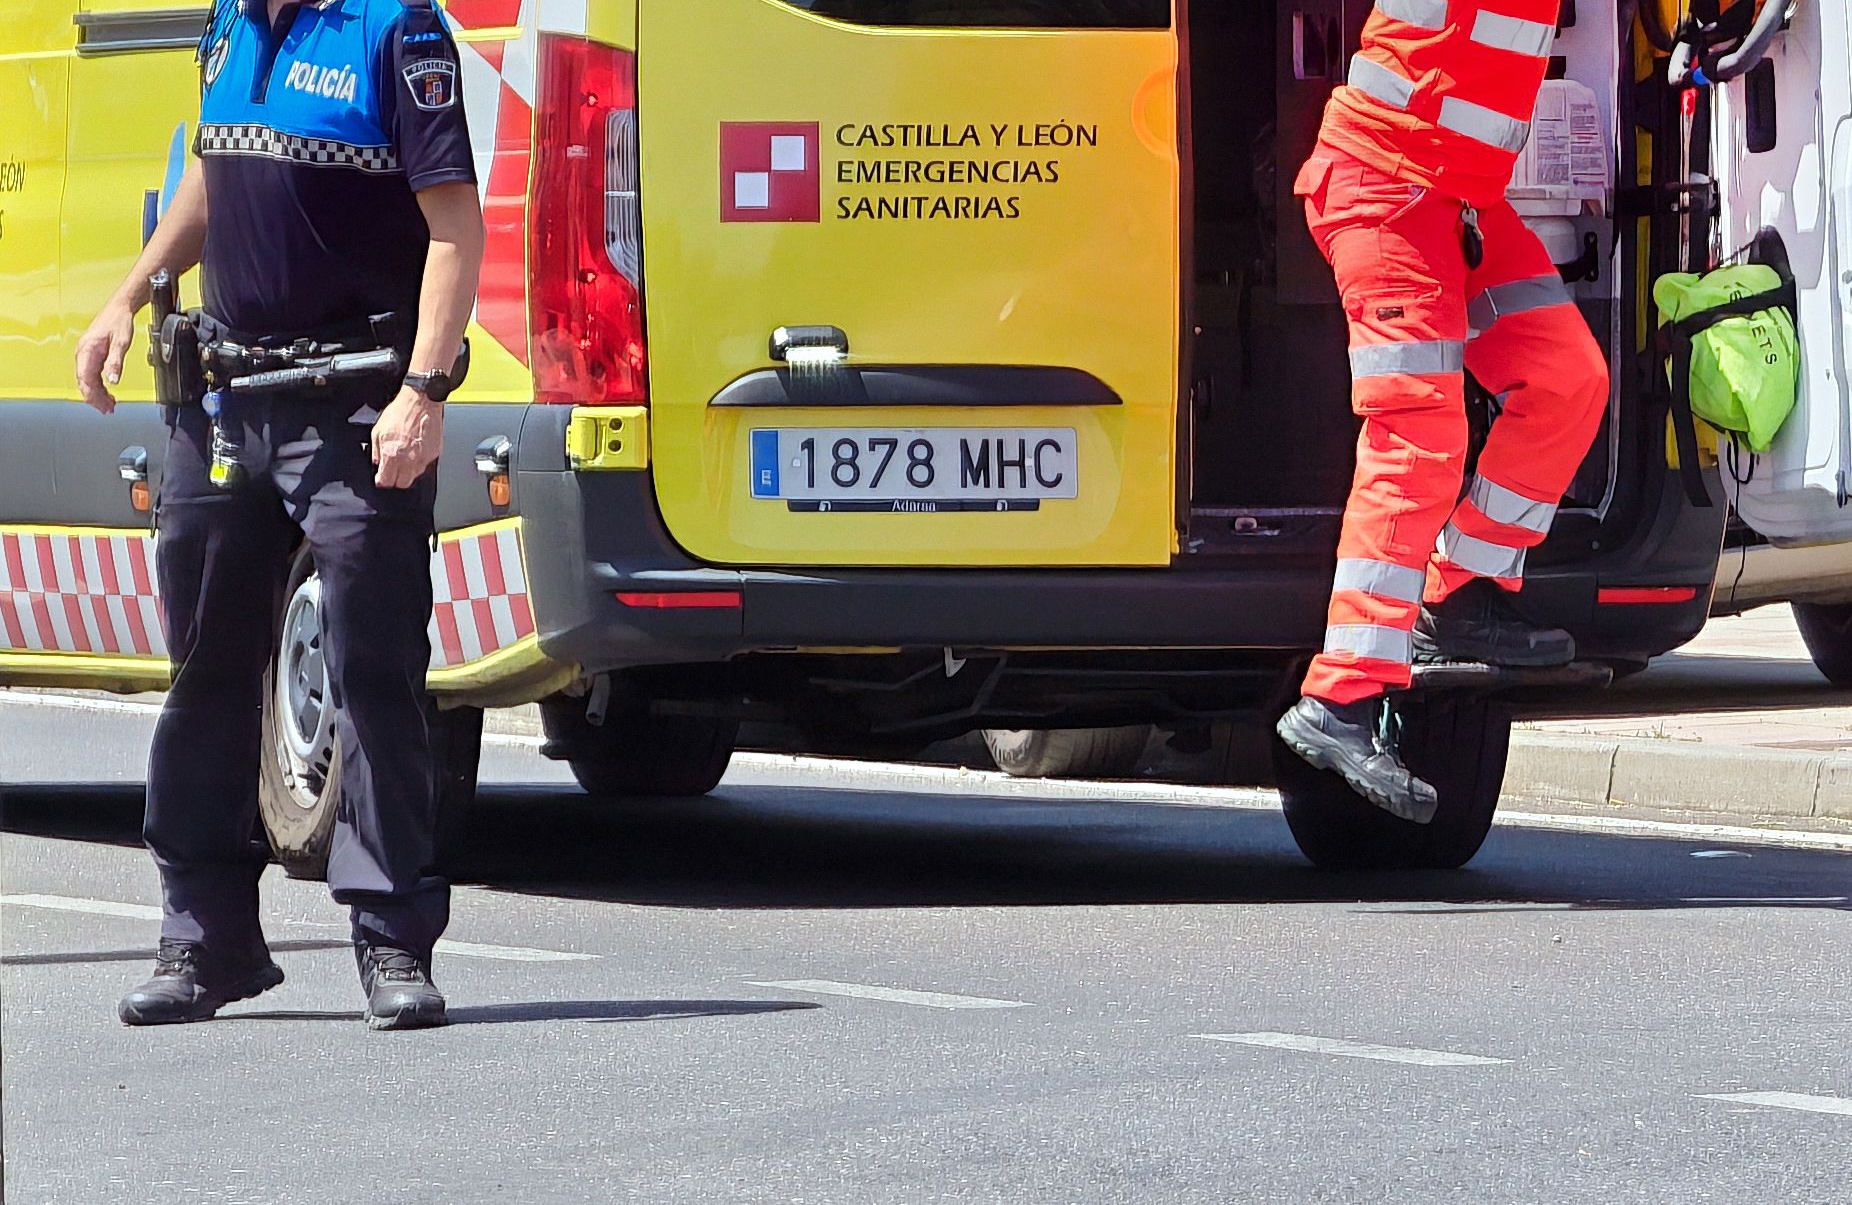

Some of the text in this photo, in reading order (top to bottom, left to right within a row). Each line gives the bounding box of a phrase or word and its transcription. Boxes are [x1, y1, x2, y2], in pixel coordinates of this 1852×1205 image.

[284, 59, 358, 104] POLICÍA
[836, 119, 1098, 147] CASTILLA Y LEÓN
[836, 160, 1060, 184] EMERGENCIAS
[836, 195, 1021, 220] SANITARIAS
[800, 437, 936, 489] 1878
[959, 437, 1063, 489] MHC
